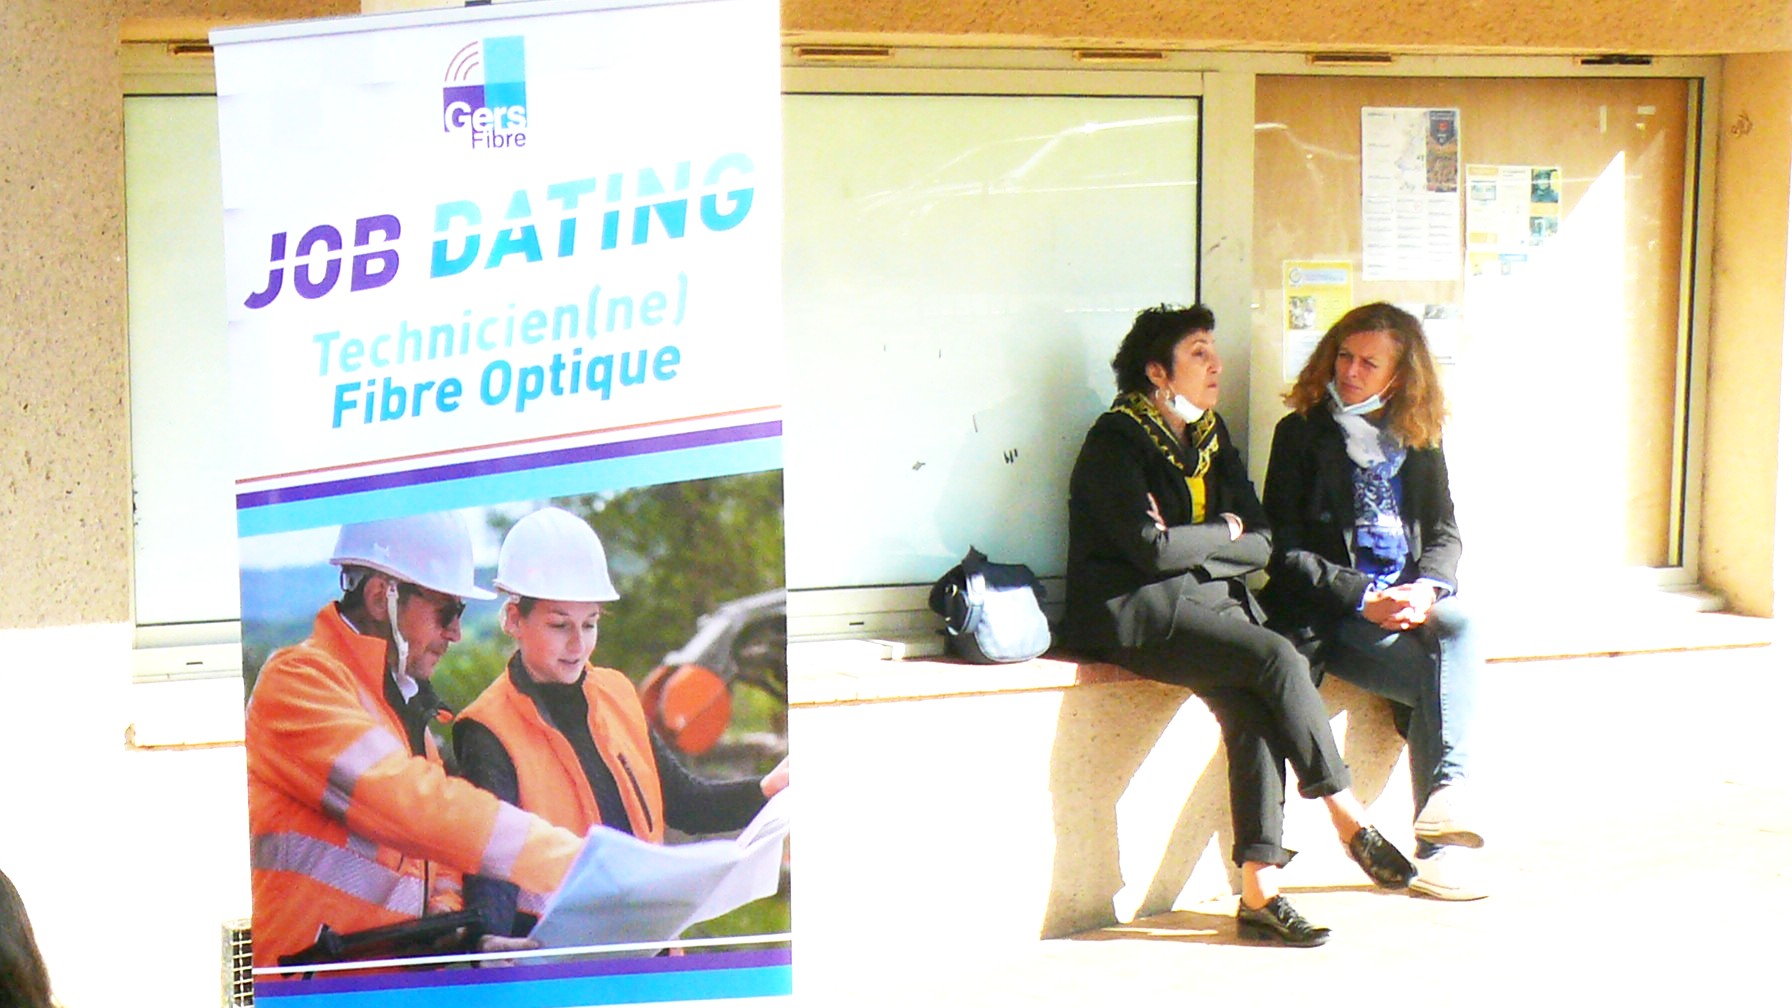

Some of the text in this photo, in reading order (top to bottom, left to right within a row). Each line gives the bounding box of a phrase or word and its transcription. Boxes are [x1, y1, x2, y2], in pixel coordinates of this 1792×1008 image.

[444, 101, 527, 132] Gers
[472, 129, 527, 150] Fibre
[243, 152, 756, 310] JOB DATING
[312, 272, 689, 377] Technicien(ne)
[331, 344, 682, 429] Fibre Optique
